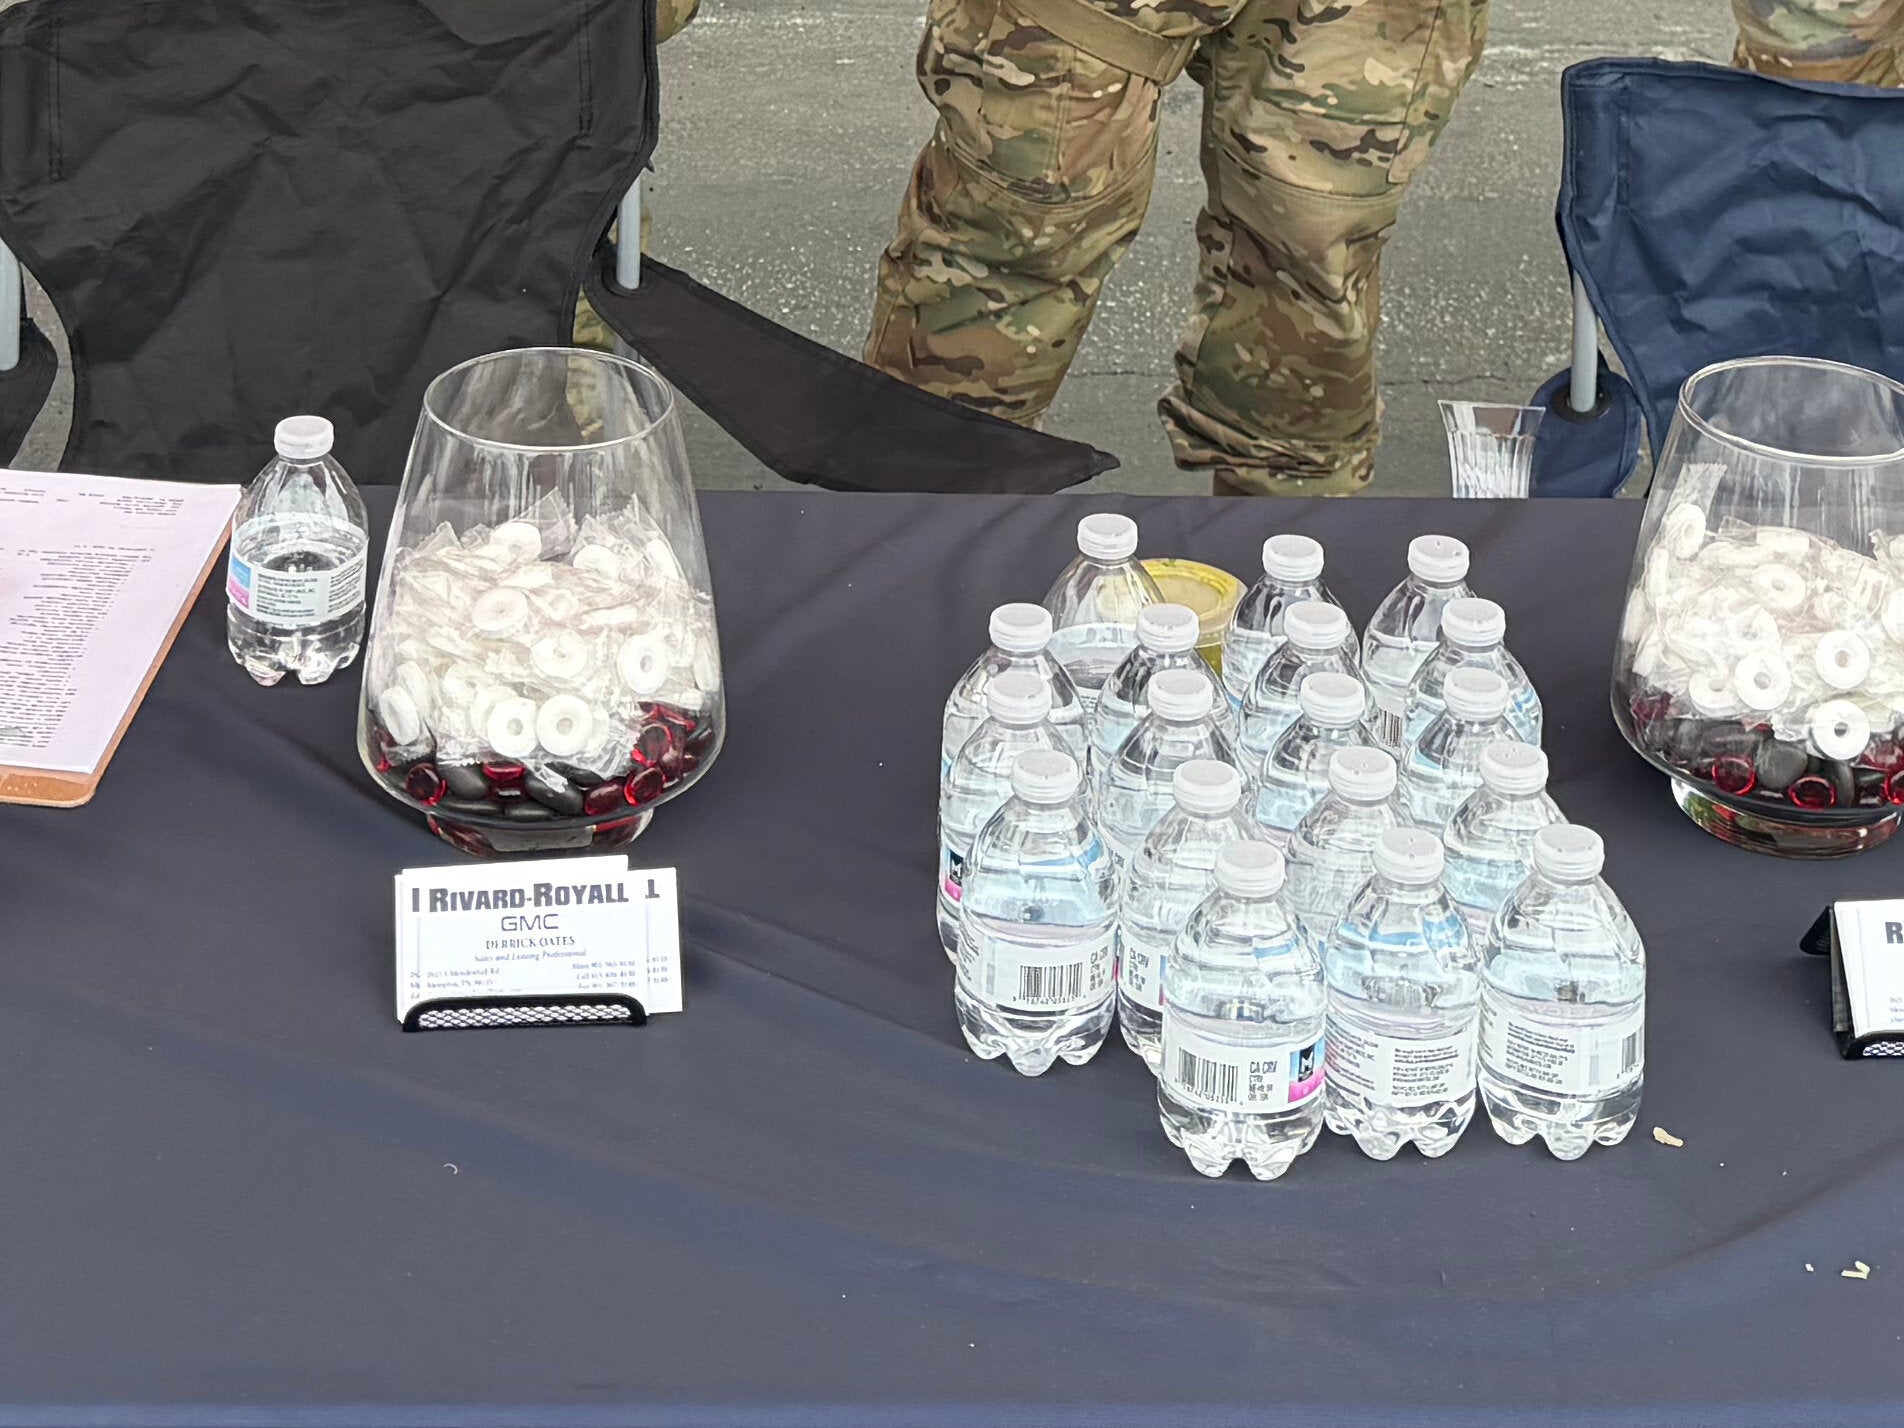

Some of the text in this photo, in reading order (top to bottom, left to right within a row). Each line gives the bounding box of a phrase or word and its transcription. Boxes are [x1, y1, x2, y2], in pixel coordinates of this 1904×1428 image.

[429, 881, 629, 913] RIVARD-ROYALL
[500, 913, 559, 932] GMC
[1249, 1060, 1261, 1074] CA
